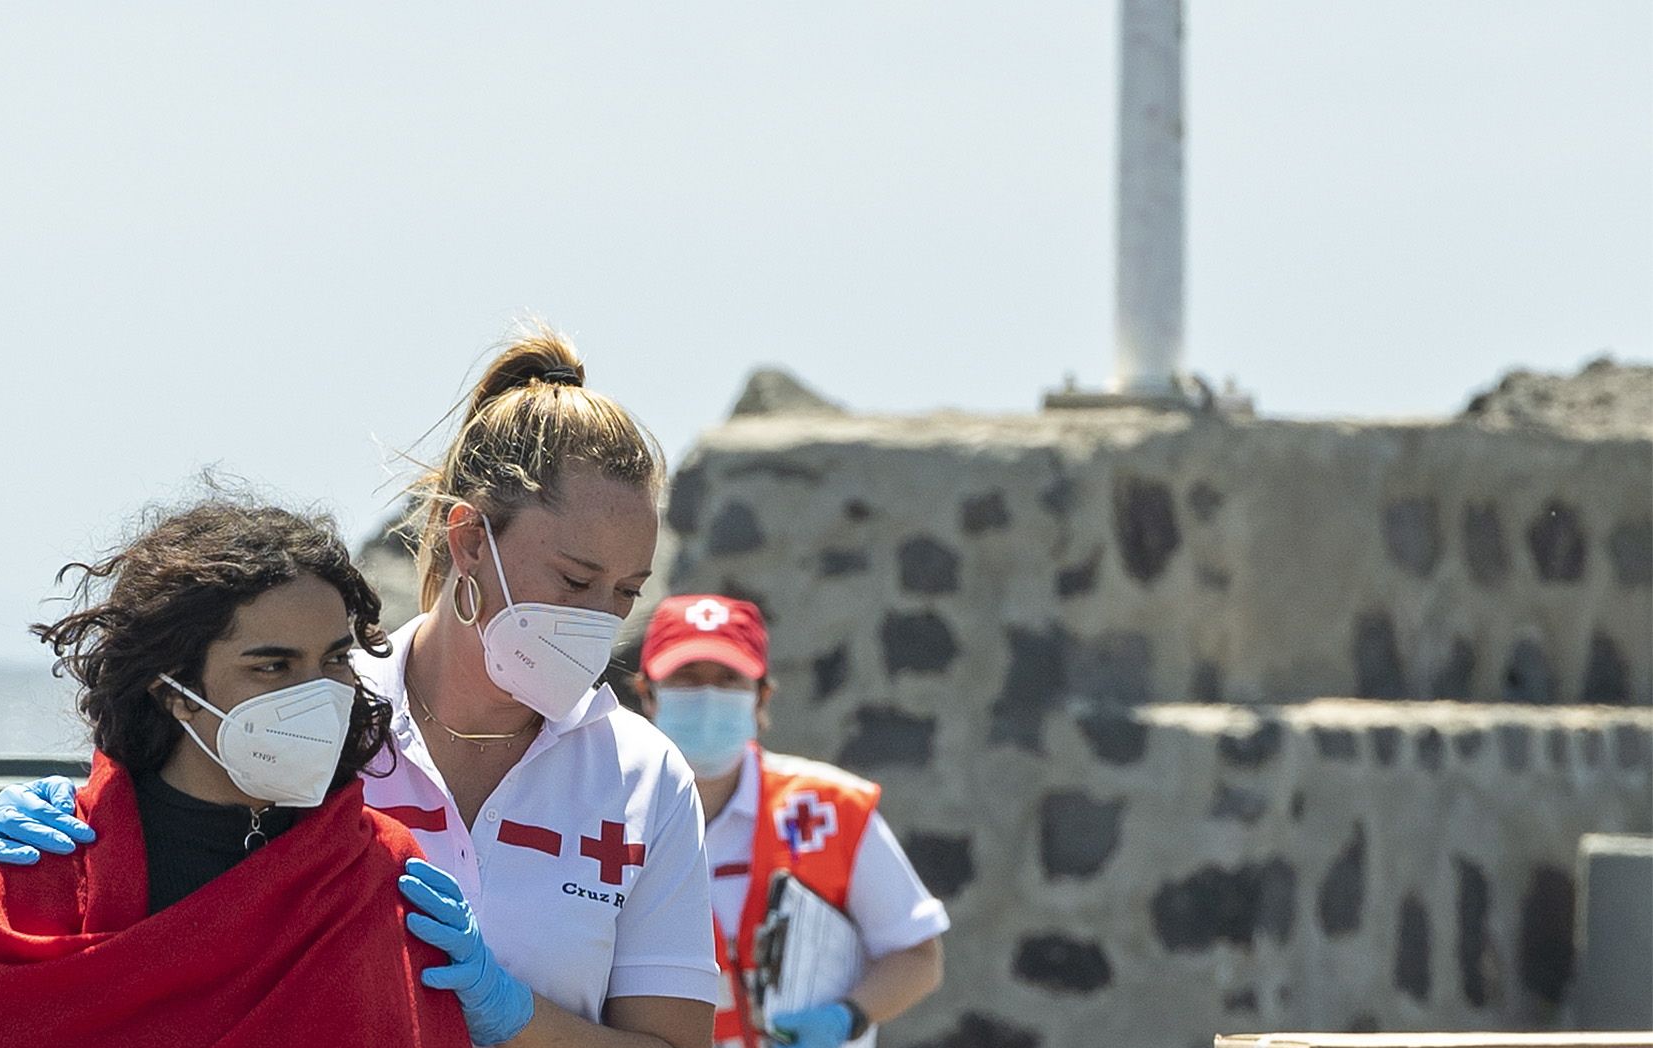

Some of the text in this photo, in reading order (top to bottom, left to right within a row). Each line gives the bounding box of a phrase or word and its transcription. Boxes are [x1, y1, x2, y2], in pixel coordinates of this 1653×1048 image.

[514, 649, 536, 669] KN95
[252, 751, 277, 764] KN95
[562, 882, 610, 903] Cruz
